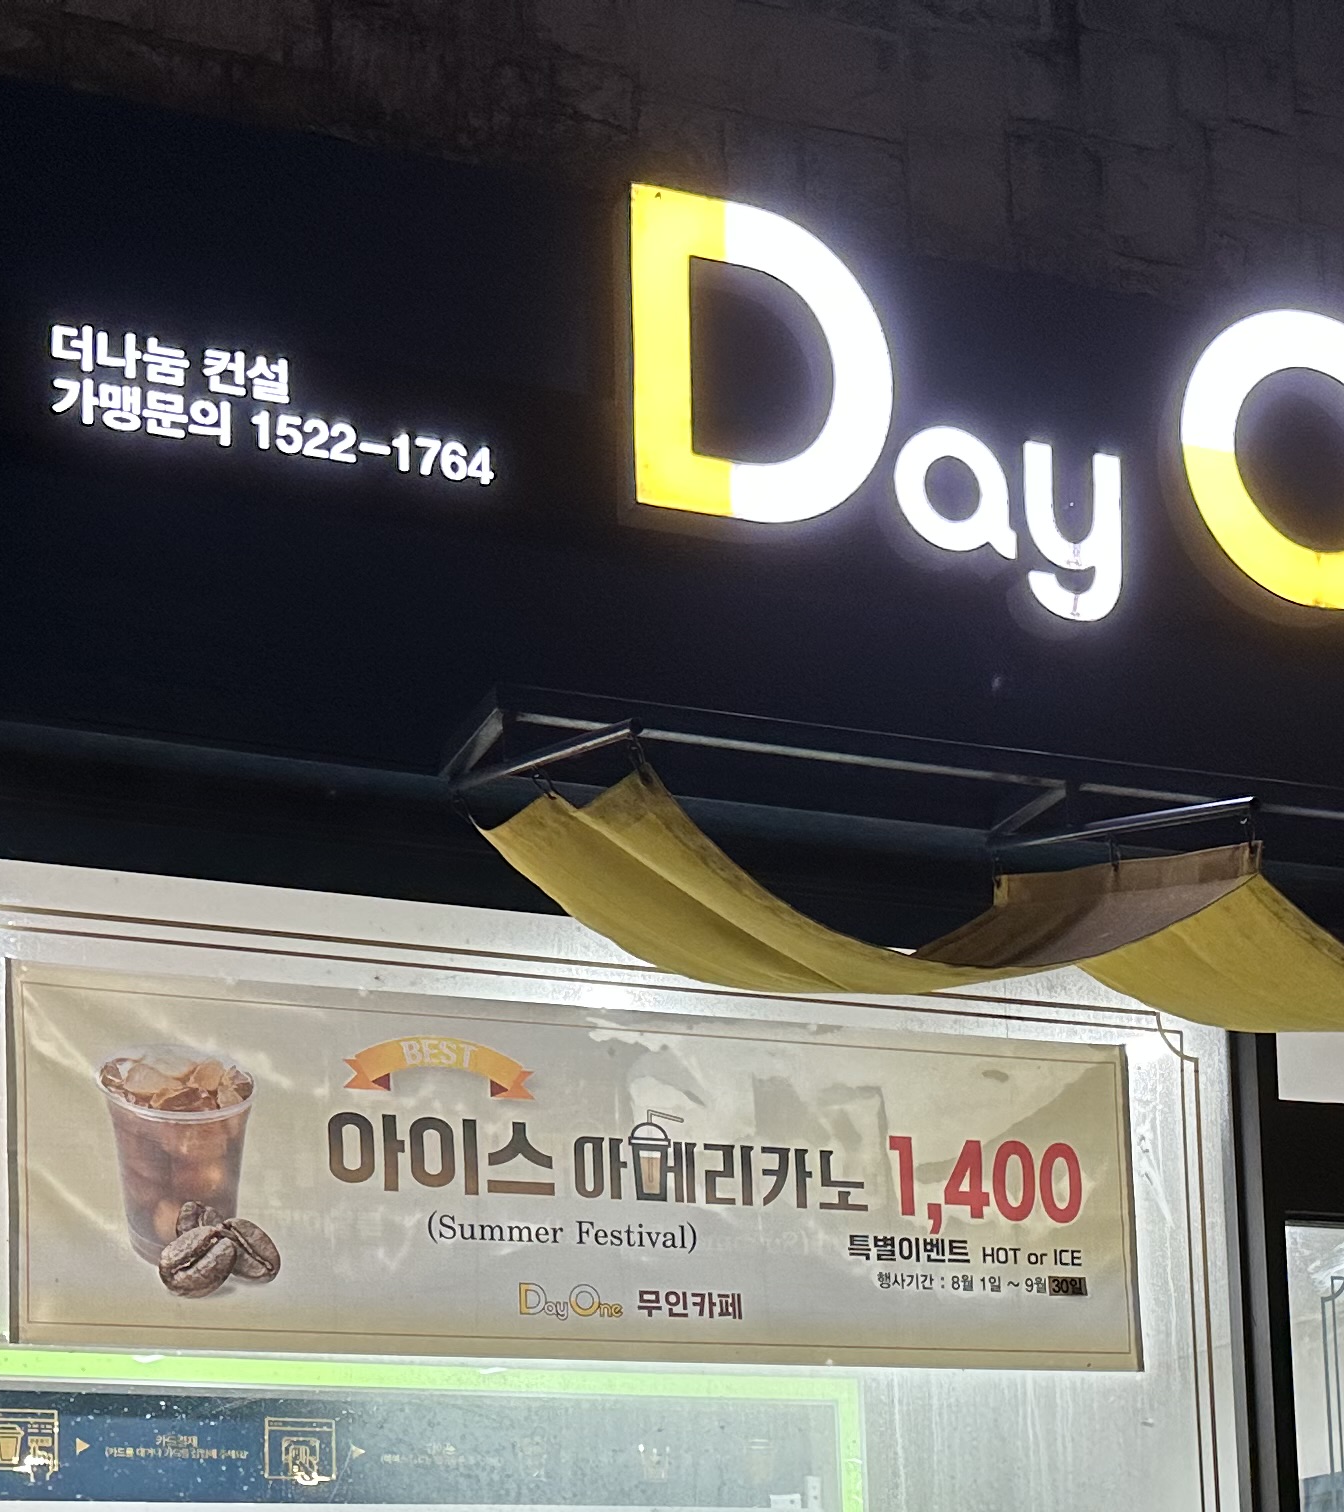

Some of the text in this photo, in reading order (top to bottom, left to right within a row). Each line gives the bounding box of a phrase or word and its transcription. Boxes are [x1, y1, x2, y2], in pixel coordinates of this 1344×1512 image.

[50, 324, 291, 405] 더나눔 컨설
[629, 182, 1123, 622] Day
[51, 376, 495, 485] 가맹문의 1522-1764
[401, 1037, 478, 1069] BEST
[328, 1112, 1083, 1235] 아이스 아메리카노 1,400
[427, 1210, 698, 1254] (Summer Festival)
[848, 1234, 1083, 1267] 특별이벤트 HOT or ICE
[877, 1271, 934, 1292] 행사기간
[638, 1289, 743, 1320] 무인카페
